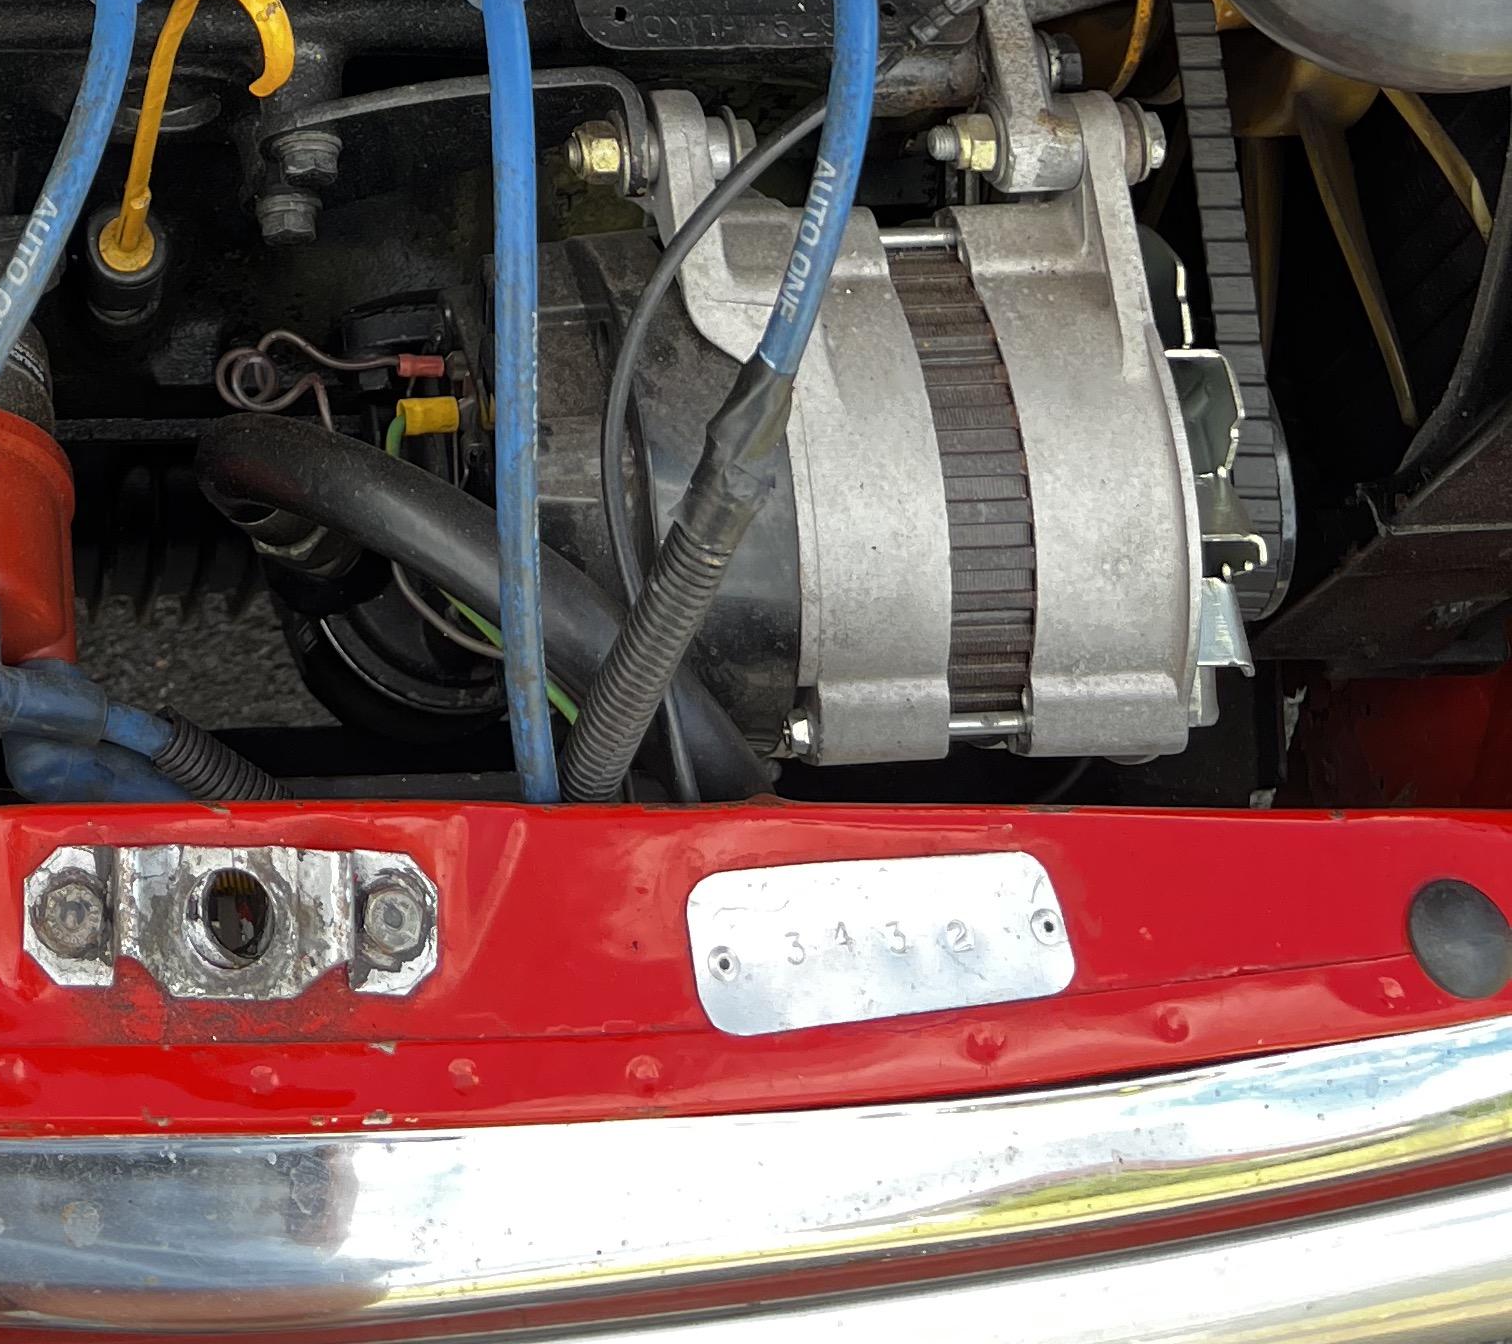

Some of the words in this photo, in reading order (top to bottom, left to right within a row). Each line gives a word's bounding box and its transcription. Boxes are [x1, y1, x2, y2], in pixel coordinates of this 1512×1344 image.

[4, 194, 59, 286] AUTO
[800, 155, 837, 247] AUTO
[779, 251, 812, 323] ONE
